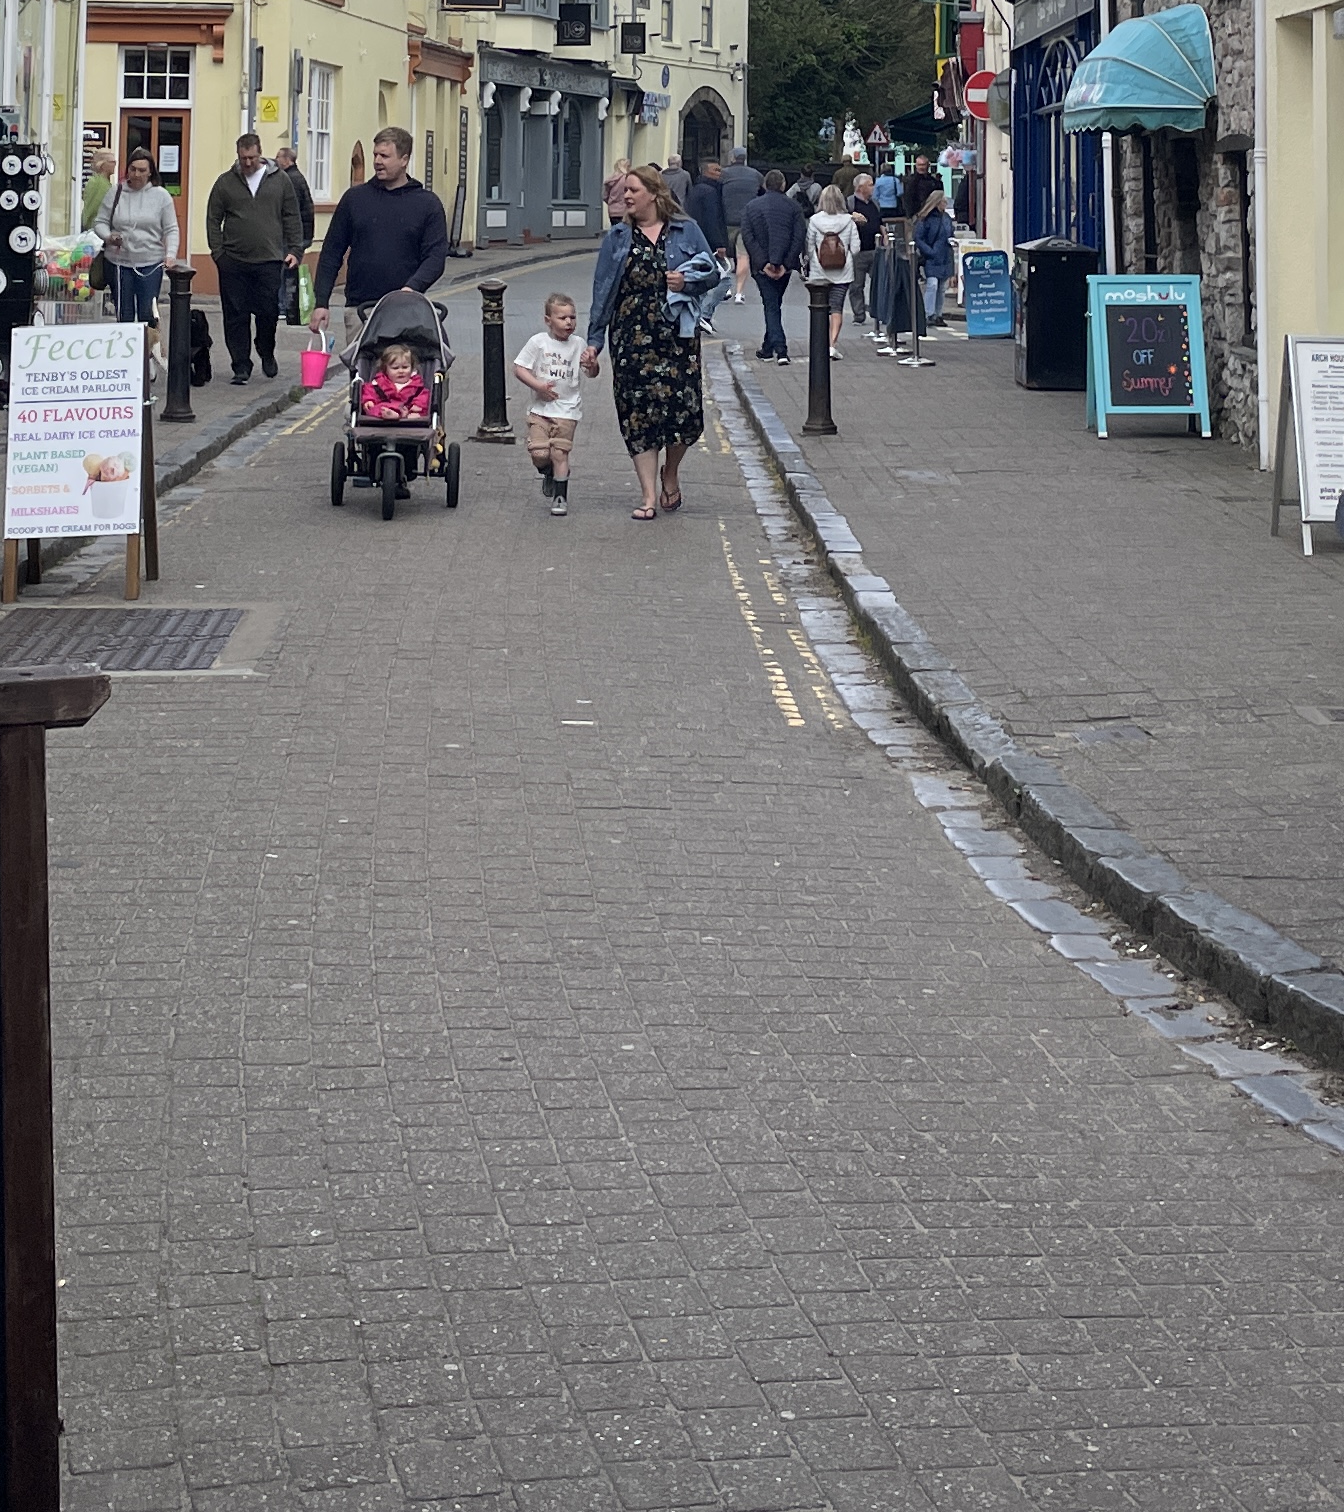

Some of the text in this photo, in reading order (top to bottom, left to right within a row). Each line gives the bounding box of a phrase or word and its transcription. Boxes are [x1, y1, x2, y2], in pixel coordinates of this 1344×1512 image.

[1105, 285, 1186, 302] moshulu
[18, 330, 137, 369] Fecci's
[1133, 349, 1154, 365] OFF
[1311, 354, 1328, 362] ARCH
[26, 369, 128, 383] TENBY'S OLDEST
[22, 383, 131, 396] ICE CREAM PARLOUR
[1122, 370, 1175, 396] Summer
[18, 406, 134, 423] 40 FLAVOURS
[13, 428, 136, 442] REAL DAIRY ICE CREAM
[13, 450, 86, 461] PLANT BASED
[12, 463, 59, 474] (VEGAN)
[11, 485, 60, 495] SORBETS
[11, 506, 79, 517] MILKSHAKES
[45, 525, 59, 534] ICE
[61, 524, 91, 533] CREAM
[113, 522, 137, 532] DOGS
